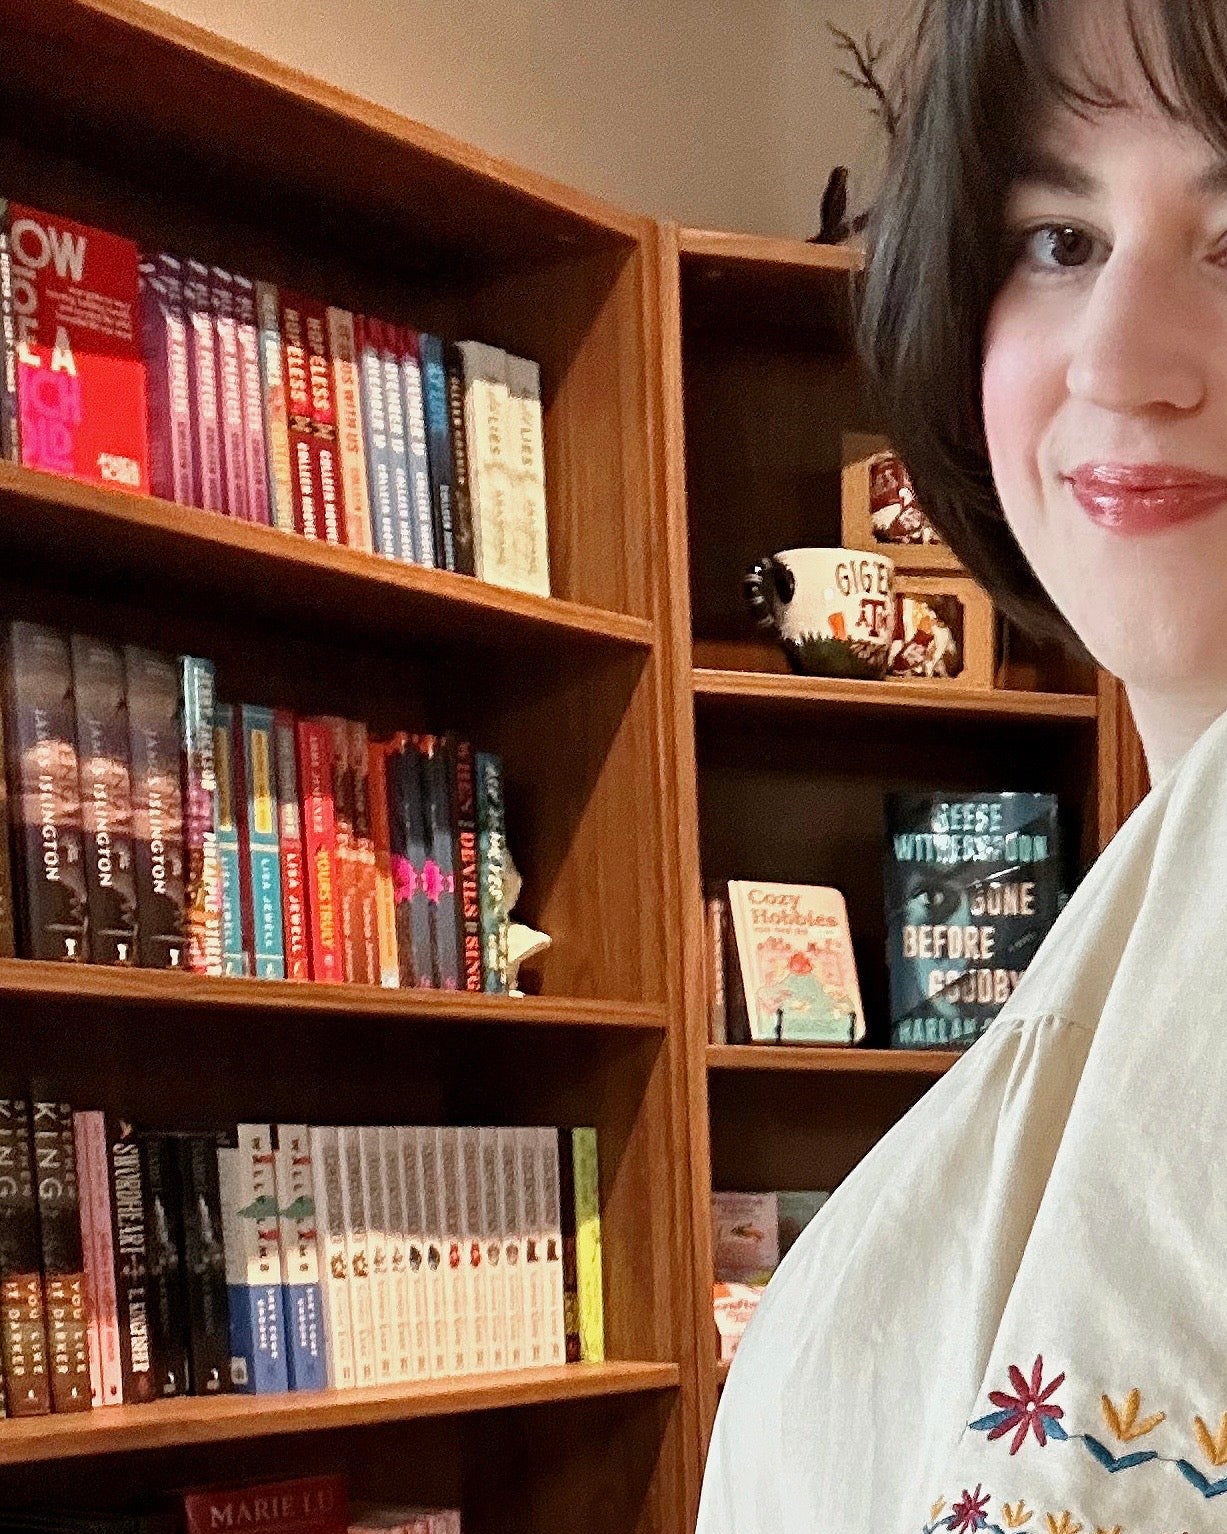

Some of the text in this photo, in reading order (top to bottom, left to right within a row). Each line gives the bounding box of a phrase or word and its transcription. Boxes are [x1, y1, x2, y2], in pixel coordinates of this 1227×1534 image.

[39, 775, 60, 880] ISLINGTON
[93, 784, 113, 887] ISLINGTON
[149, 792, 166, 894] ISLINGTON
[202, 832, 219, 913] PINEAPPLE
[261, 858, 274, 947] LISA JEWELL
[287, 853, 302, 952] LISA JEWELL
[459, 832, 478, 917] DEVILS
[748, 889, 800, 912] Cozy
[970, 881, 1038, 917] GONE
[317, 903, 334, 948] TRULY
[751, 909, 838, 927] Hobbies
[903, 925, 996, 960] BEFORE
[465, 936, 481, 992] SING
[34, 1102, 62, 1200] KING
[113, 1143, 145, 1254] SWORDHEART
[28, 1282, 37, 1319] YOU
[71, 1282, 81, 1319] YOU
[8, 1309, 25, 1375] DARKER
[52, 1308, 68, 1373] DARKER
[209, 1498, 291, 1529] MARIE
